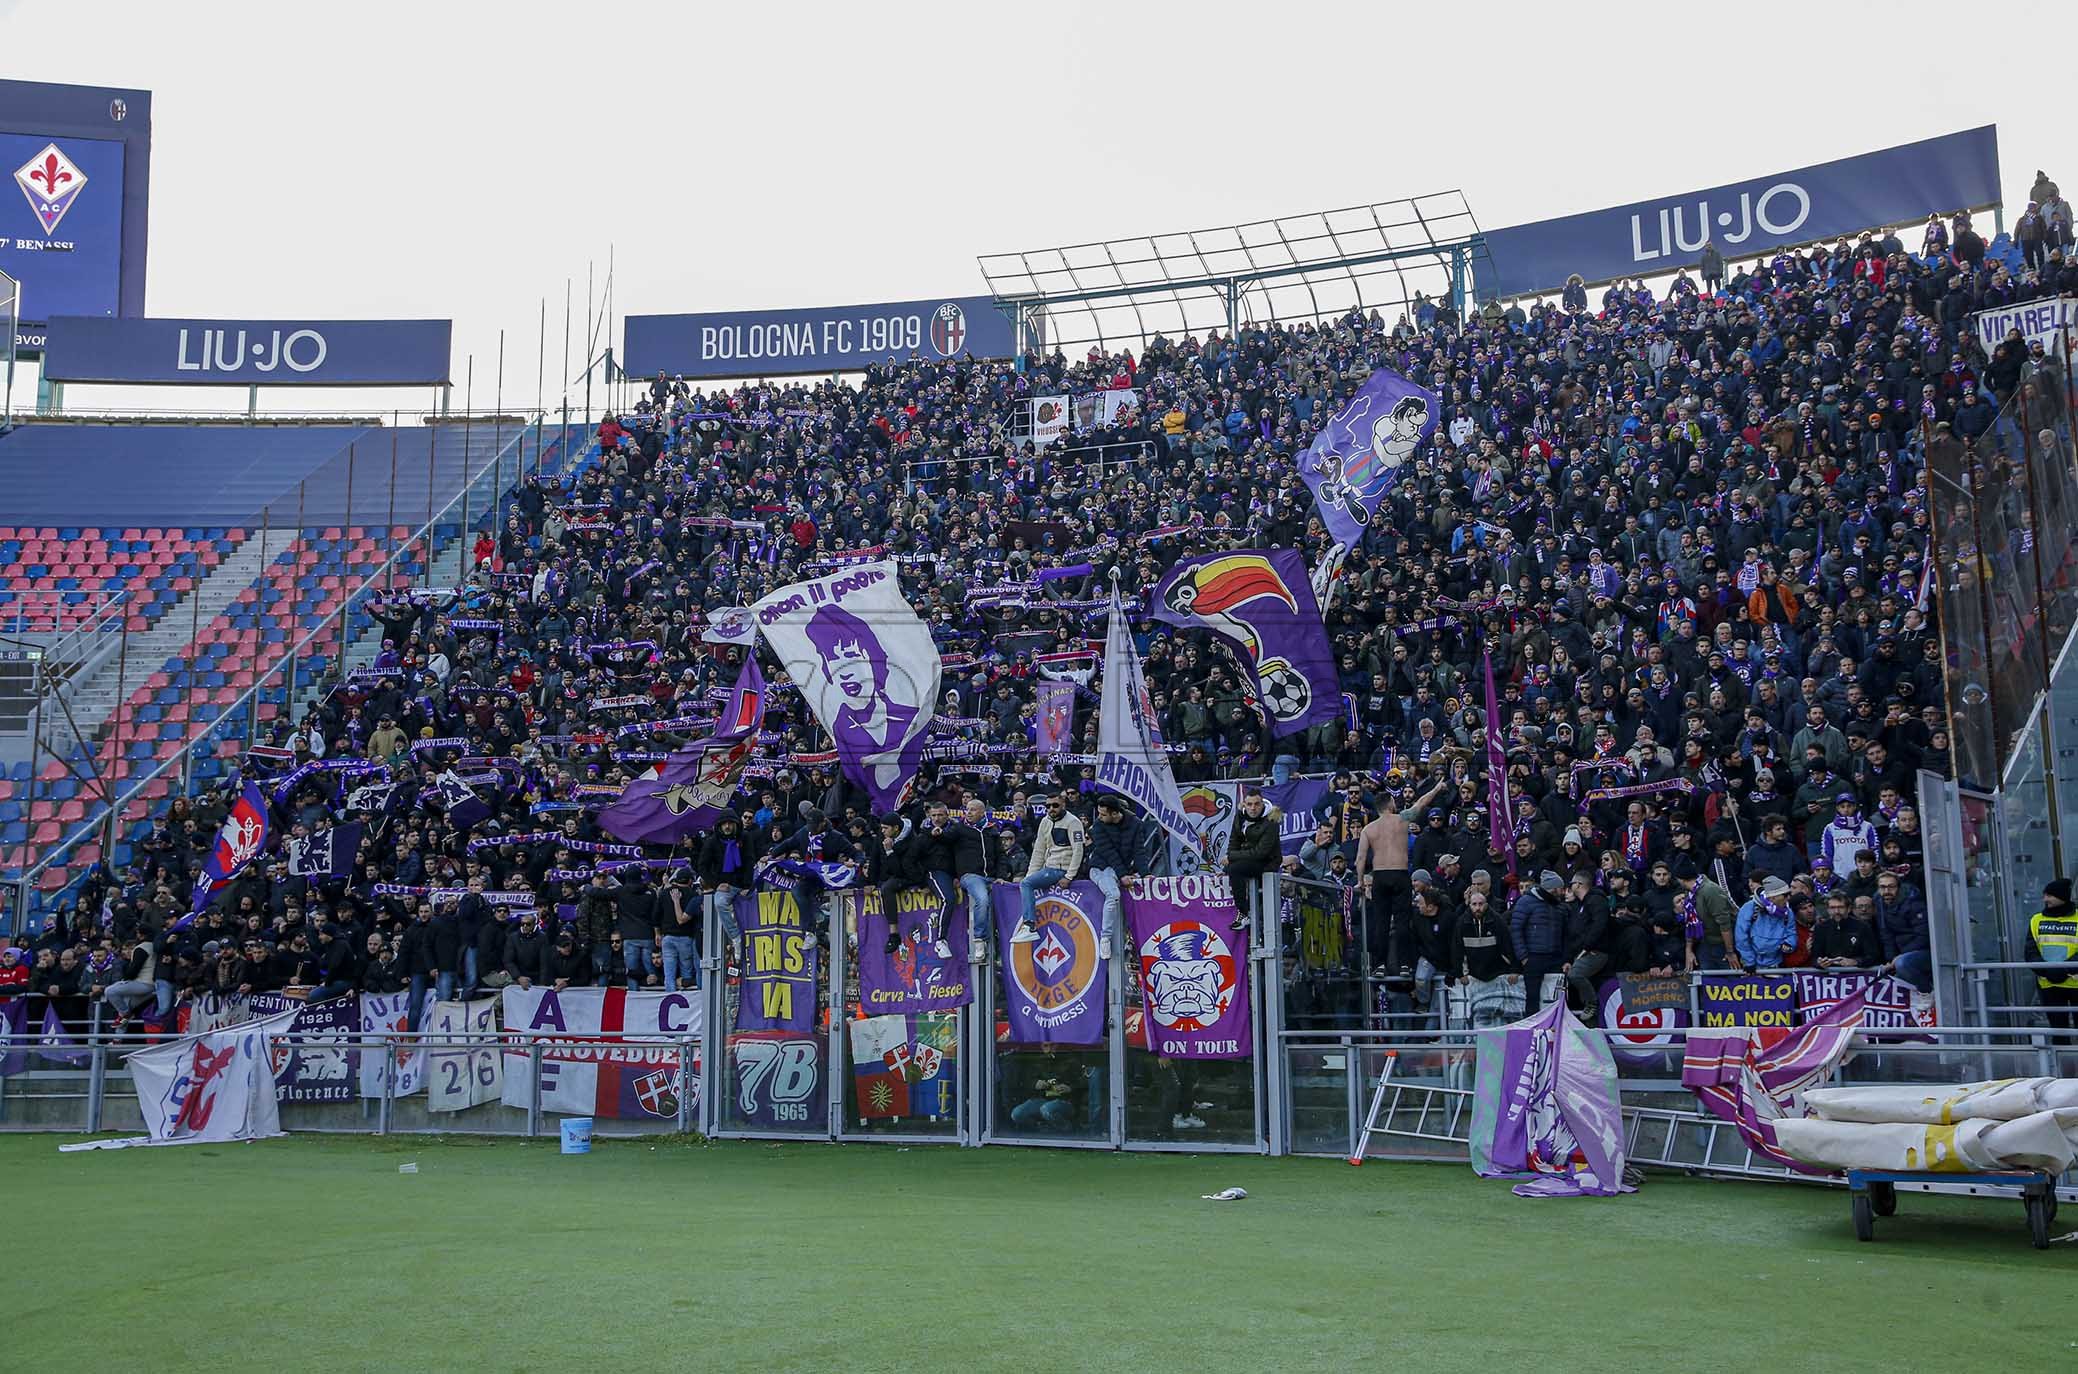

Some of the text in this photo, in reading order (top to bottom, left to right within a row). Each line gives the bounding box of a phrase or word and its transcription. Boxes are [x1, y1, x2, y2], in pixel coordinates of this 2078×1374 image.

[702, 315, 921, 360] BOLOGNA FC 1909
[1836, 837, 1867, 845] TOYOTA
[1048, 885, 1083, 904] scesi
[871, 988, 905, 1003] Curva
[1638, 981, 1679, 993] CALCIO
[1705, 984, 1793, 1001] VACILLO
[1801, 974, 1907, 1007] FIRENZE
[300, 1013, 334, 1025] 1926
[528, 990, 690, 1034] A C
[1706, 1010, 1792, 1027] MA NON
[1162, 1039, 1240, 1054] ON TOUR
[441, 1052, 495, 1095] 2 6
[275, 1085, 350, 1101] Florence
[770, 1102, 808, 1121] 1965
